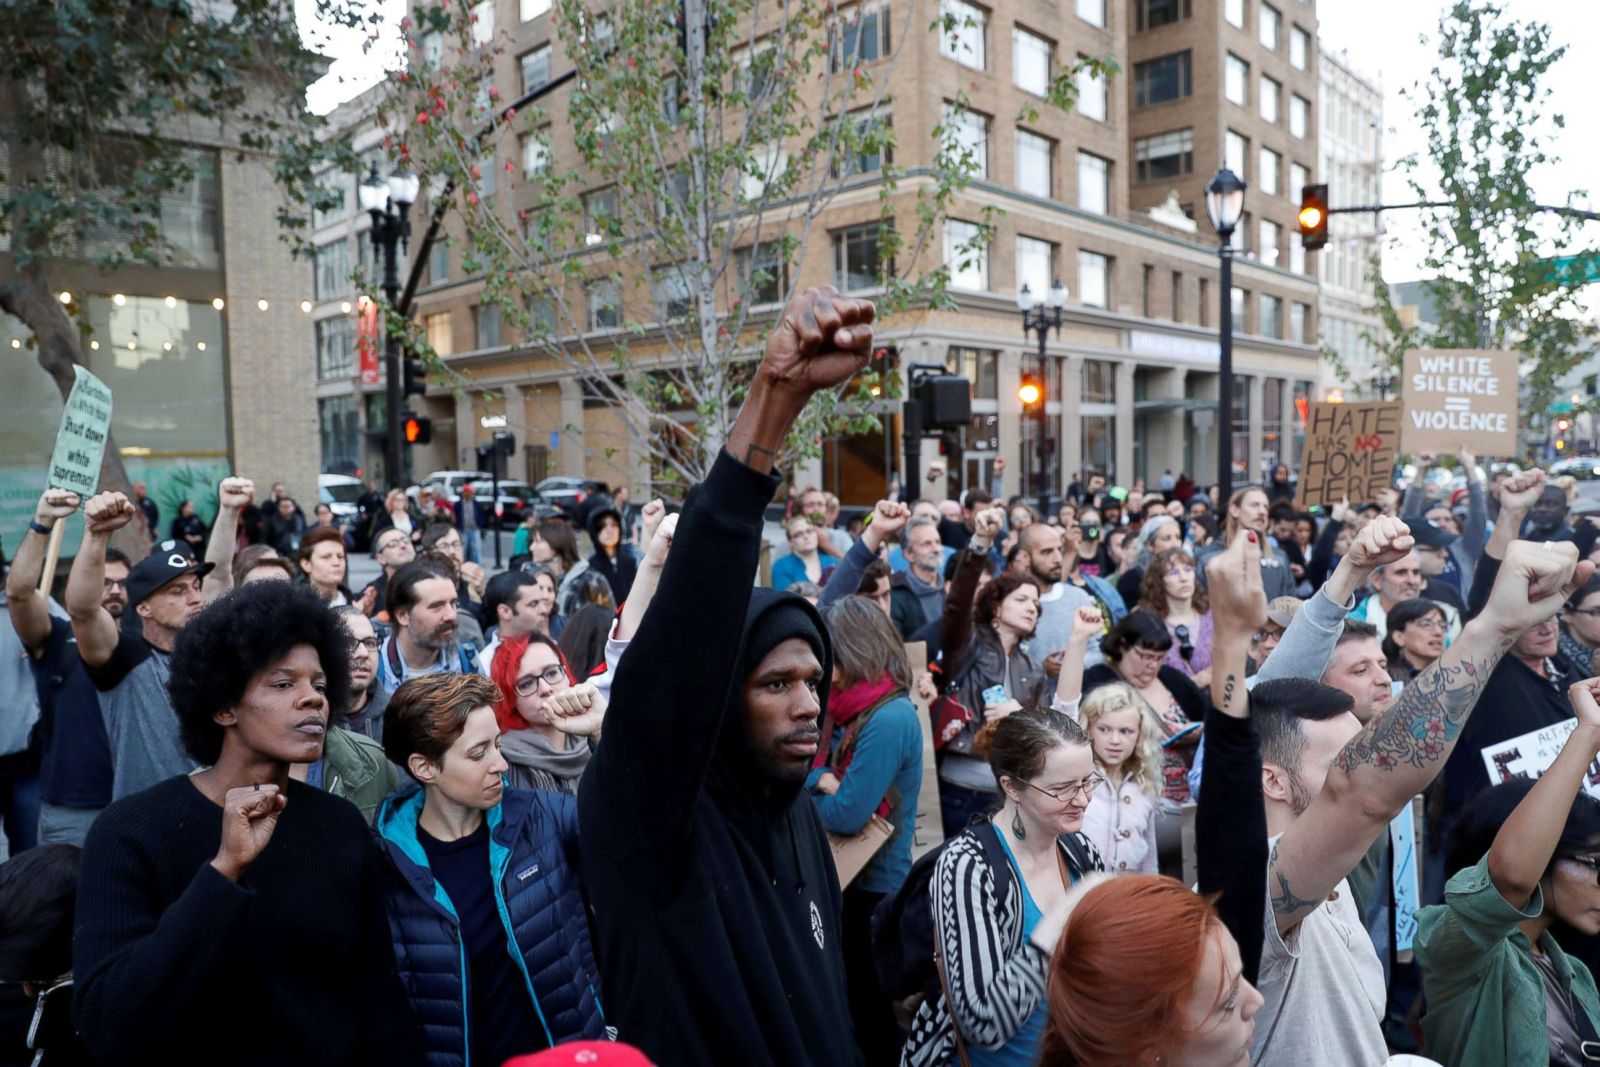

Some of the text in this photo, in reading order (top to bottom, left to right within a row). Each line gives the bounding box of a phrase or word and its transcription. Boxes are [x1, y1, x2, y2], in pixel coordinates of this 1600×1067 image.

[1419, 356, 1493, 376] WHITE
[1412, 373, 1499, 396] SILENCE
[1312, 407, 1399, 435] HATE
[1410, 410, 1508, 432] VIOLENCE
[84, 426, 105, 444] down
[1315, 433, 1383, 453] HAS NO
[67, 450, 91, 468] white
[1306, 447, 1393, 477] HOME
[1302, 476, 1388, 505] HERE
